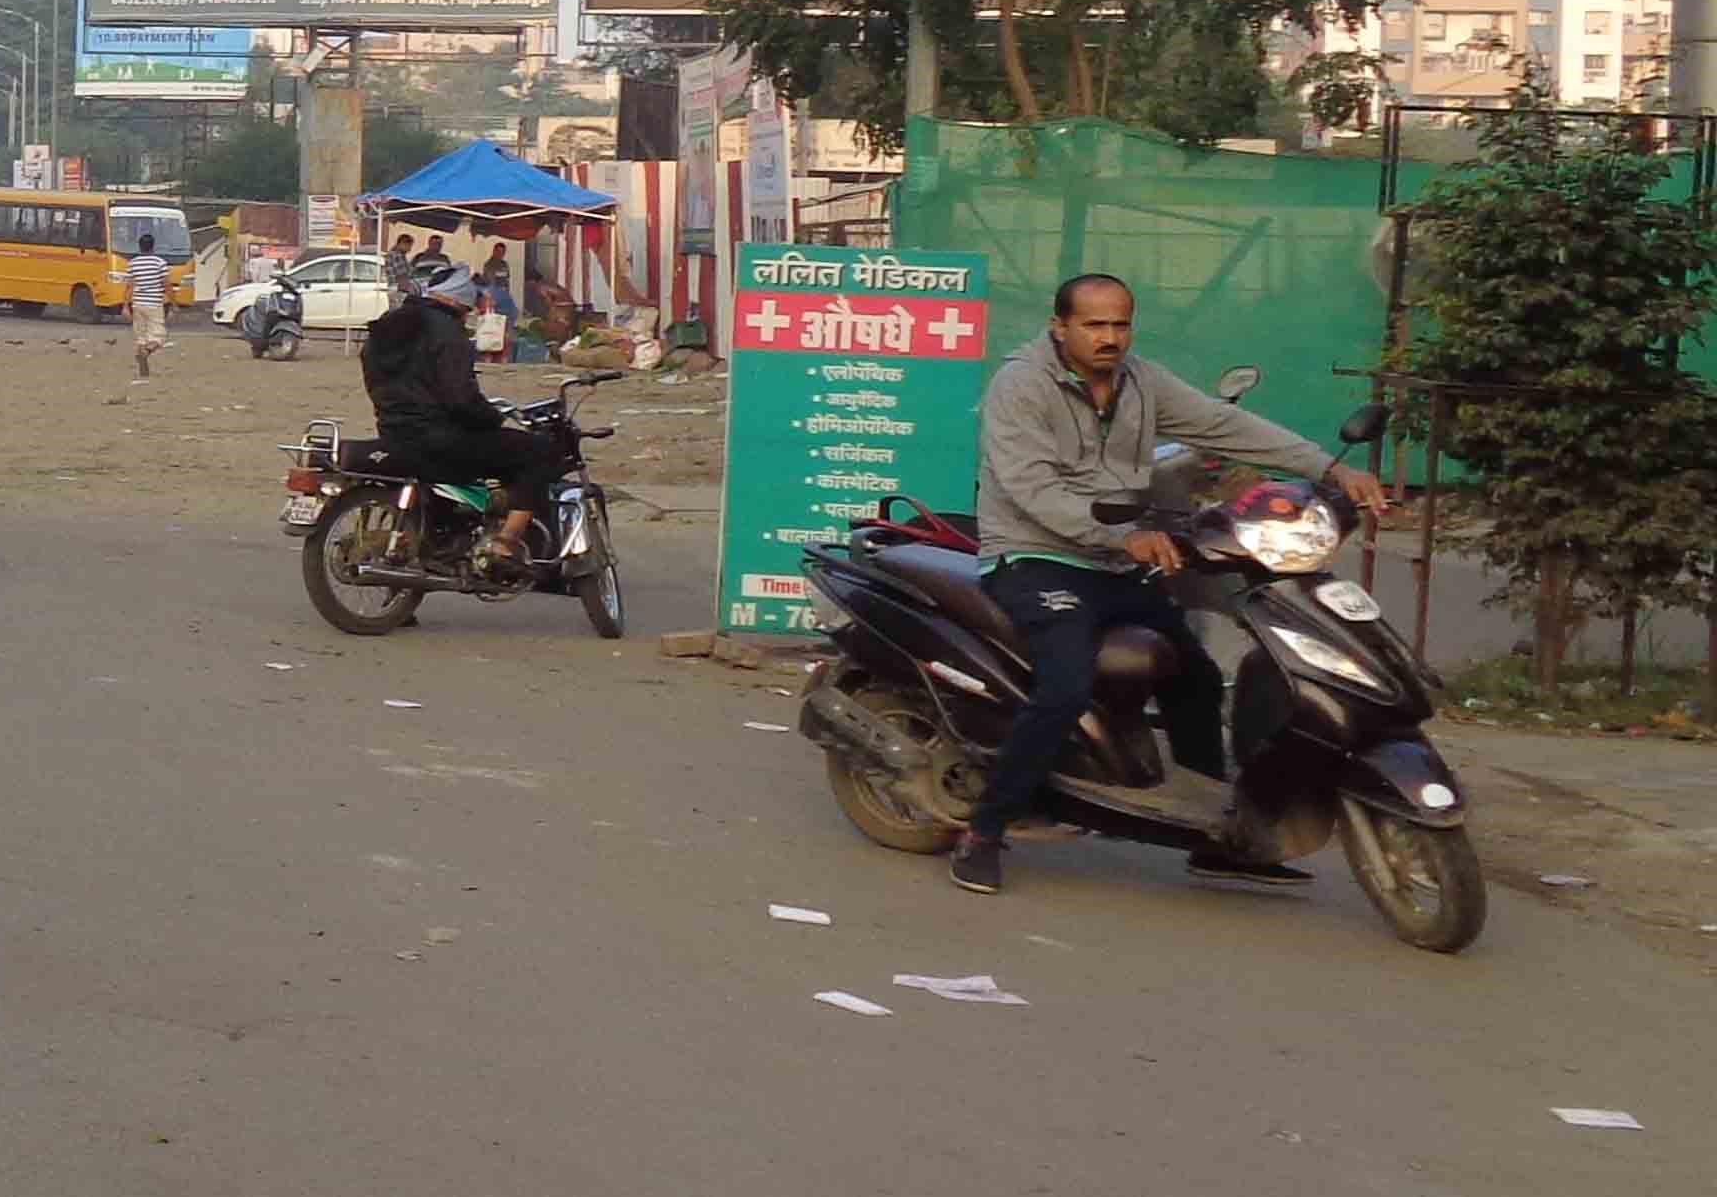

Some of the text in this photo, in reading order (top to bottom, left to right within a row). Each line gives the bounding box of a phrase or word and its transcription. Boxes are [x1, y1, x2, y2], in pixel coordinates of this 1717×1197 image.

[751, 251, 970, 291] ललित मेडिकल
[799, 292, 916, 353] औषधे
[730, 603, 757, 626] M
